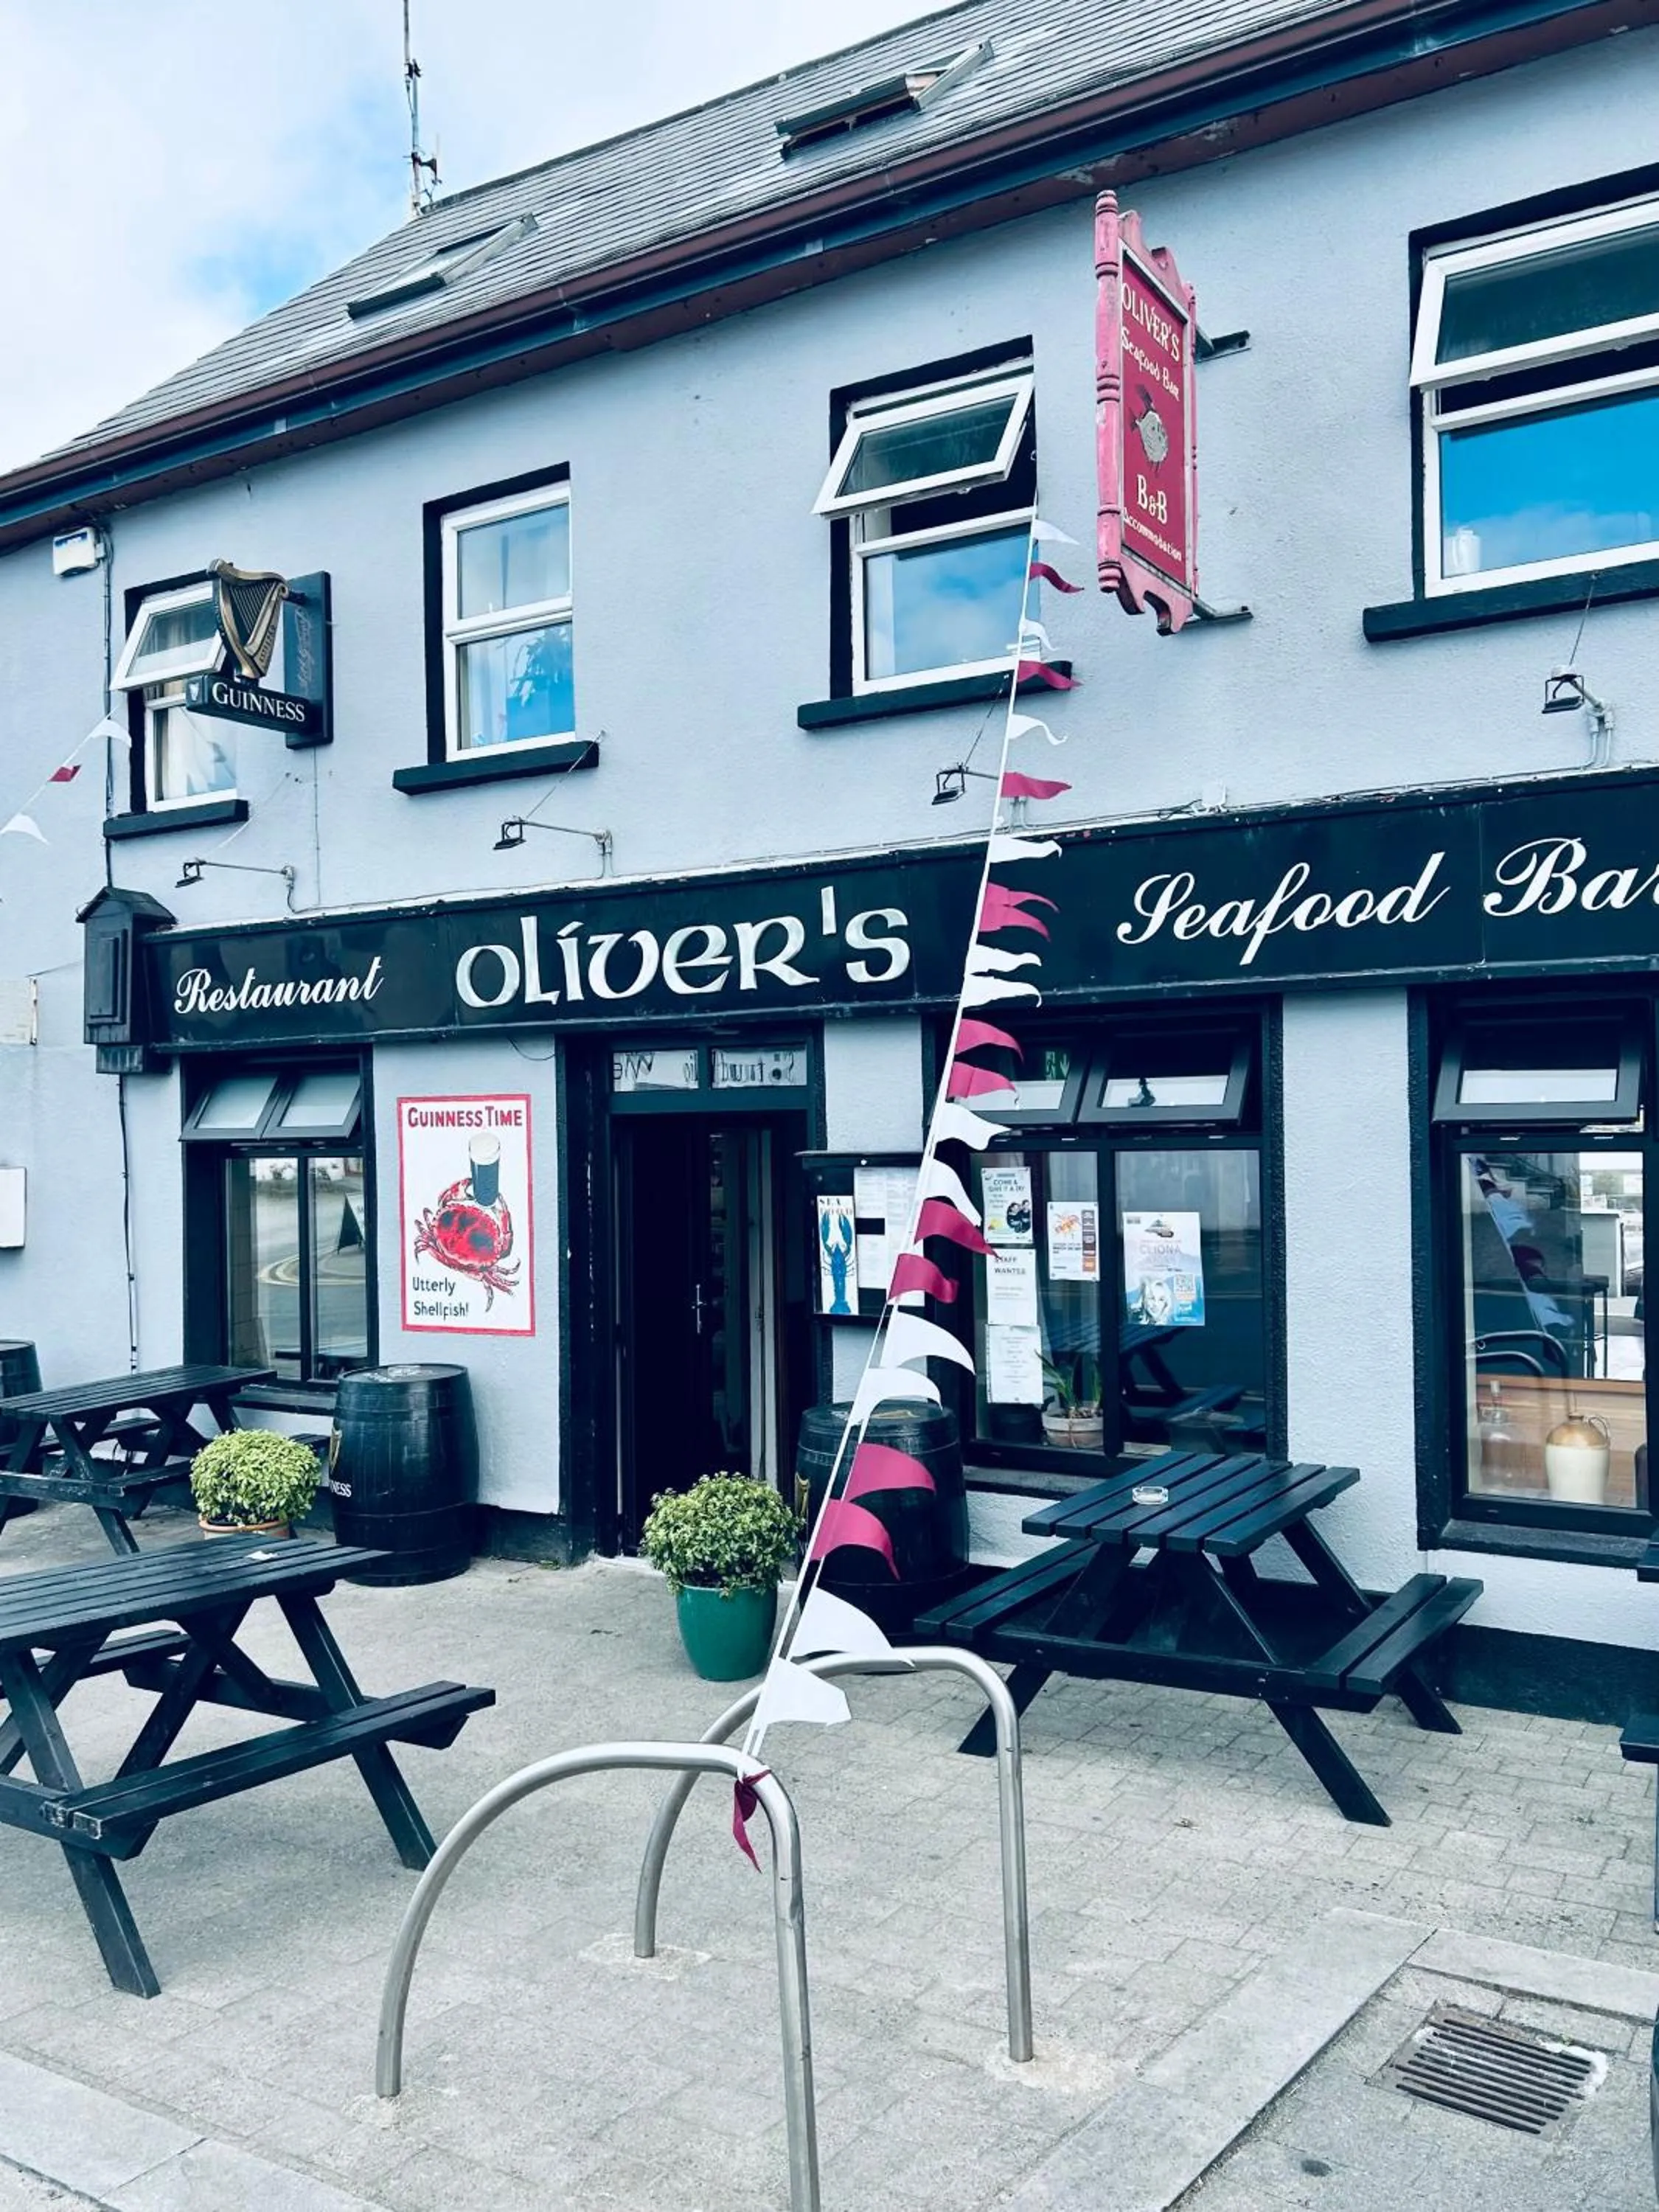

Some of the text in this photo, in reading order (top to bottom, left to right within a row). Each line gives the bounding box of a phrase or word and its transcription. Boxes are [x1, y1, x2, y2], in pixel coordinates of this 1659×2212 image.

[1122, 282, 1180, 362] OLIVER'S
[1121, 326, 1180, 401] Seafood Bar
[1136, 474, 1167, 524] B&B
[1116, 852, 1451, 965] Seafood
[174, 956, 384, 1014] Restaurant
[413, 1277, 456, 1296] Utterly
